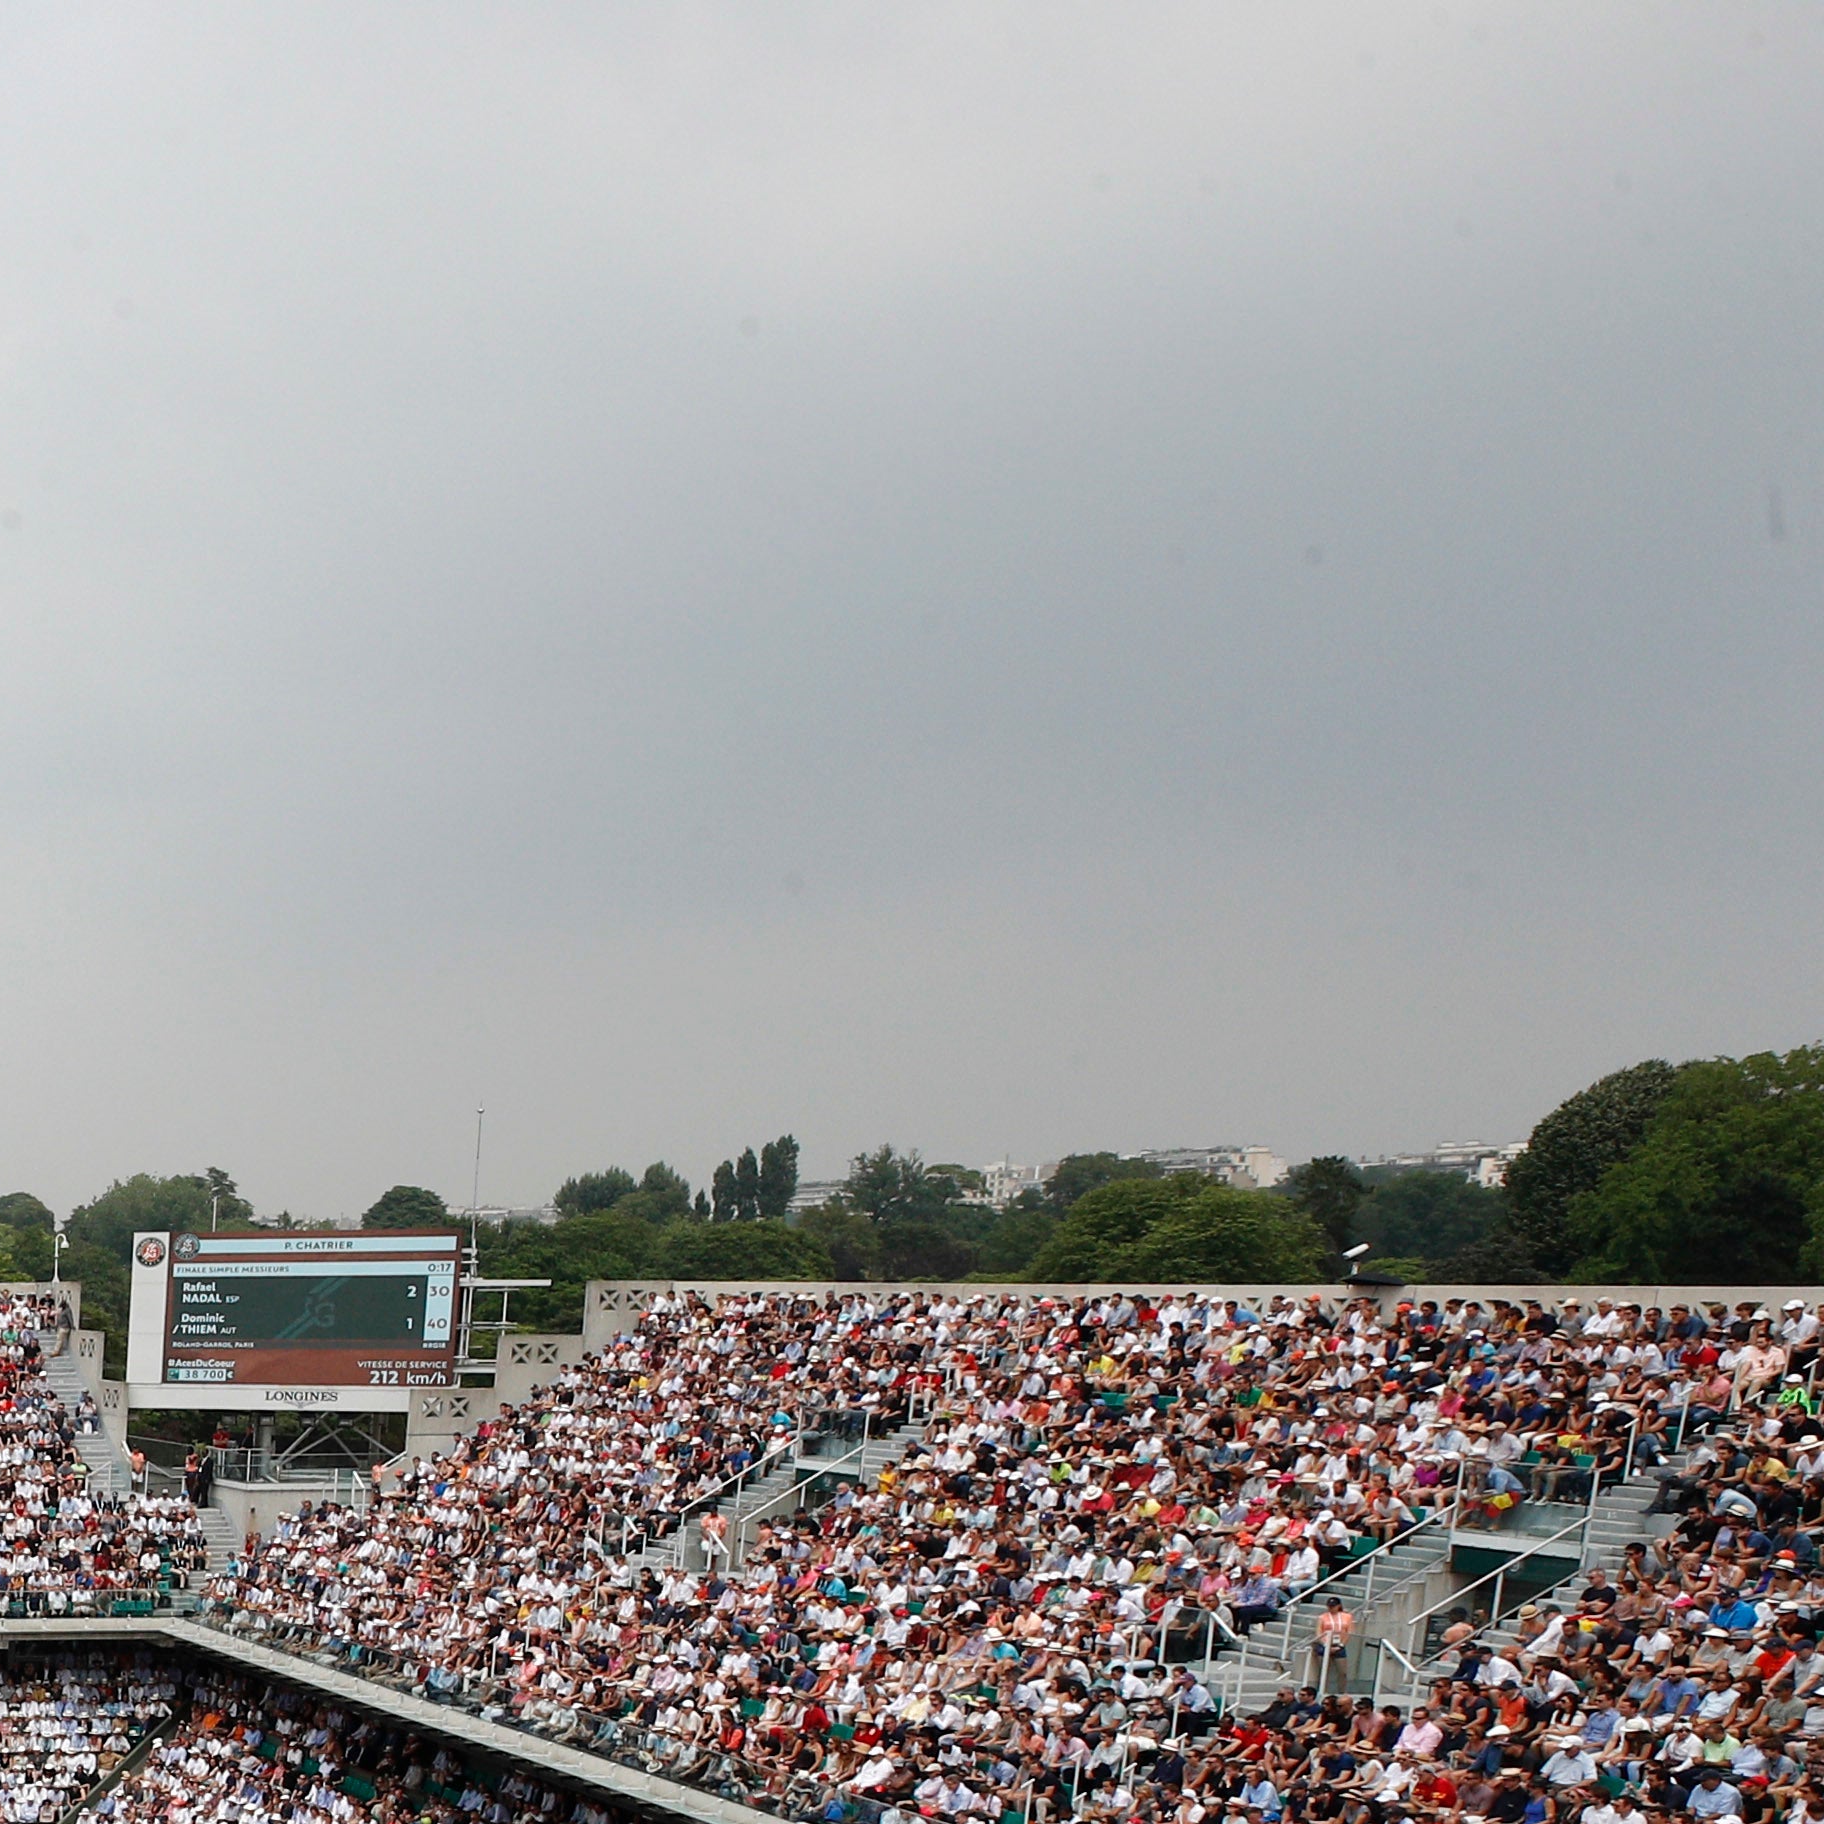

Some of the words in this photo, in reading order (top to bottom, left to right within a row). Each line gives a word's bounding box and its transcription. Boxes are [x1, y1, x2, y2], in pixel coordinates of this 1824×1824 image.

[284, 1242, 293, 1250] P.
[296, 1241, 353, 1250] CHATRIER
[427, 1263, 451, 1272] 0:17
[183, 1282, 216, 1291] Rafael
[407, 1285, 417, 1297] 2
[429, 1286, 450, 1296] 30
[182, 1294, 222, 1303] NADAL
[181, 1313, 225, 1323] Dominic
[406, 1318, 413, 1329] 1
[427, 1318, 447, 1329] 40
[168, 1359, 236, 1367] #AcesDuCoeur
[357, 1360, 393, 1368] VITESSE
[395, 1360, 407, 1368] DE
[409, 1360, 447, 1368] SERVICE
[184, 1370, 199, 1379] 38
[203, 1370, 224, 1378] 700
[369, 1370, 399, 1384] 212
[406, 1371, 447, 1385] km/h
[265, 1391, 338, 1401] LONGINES
